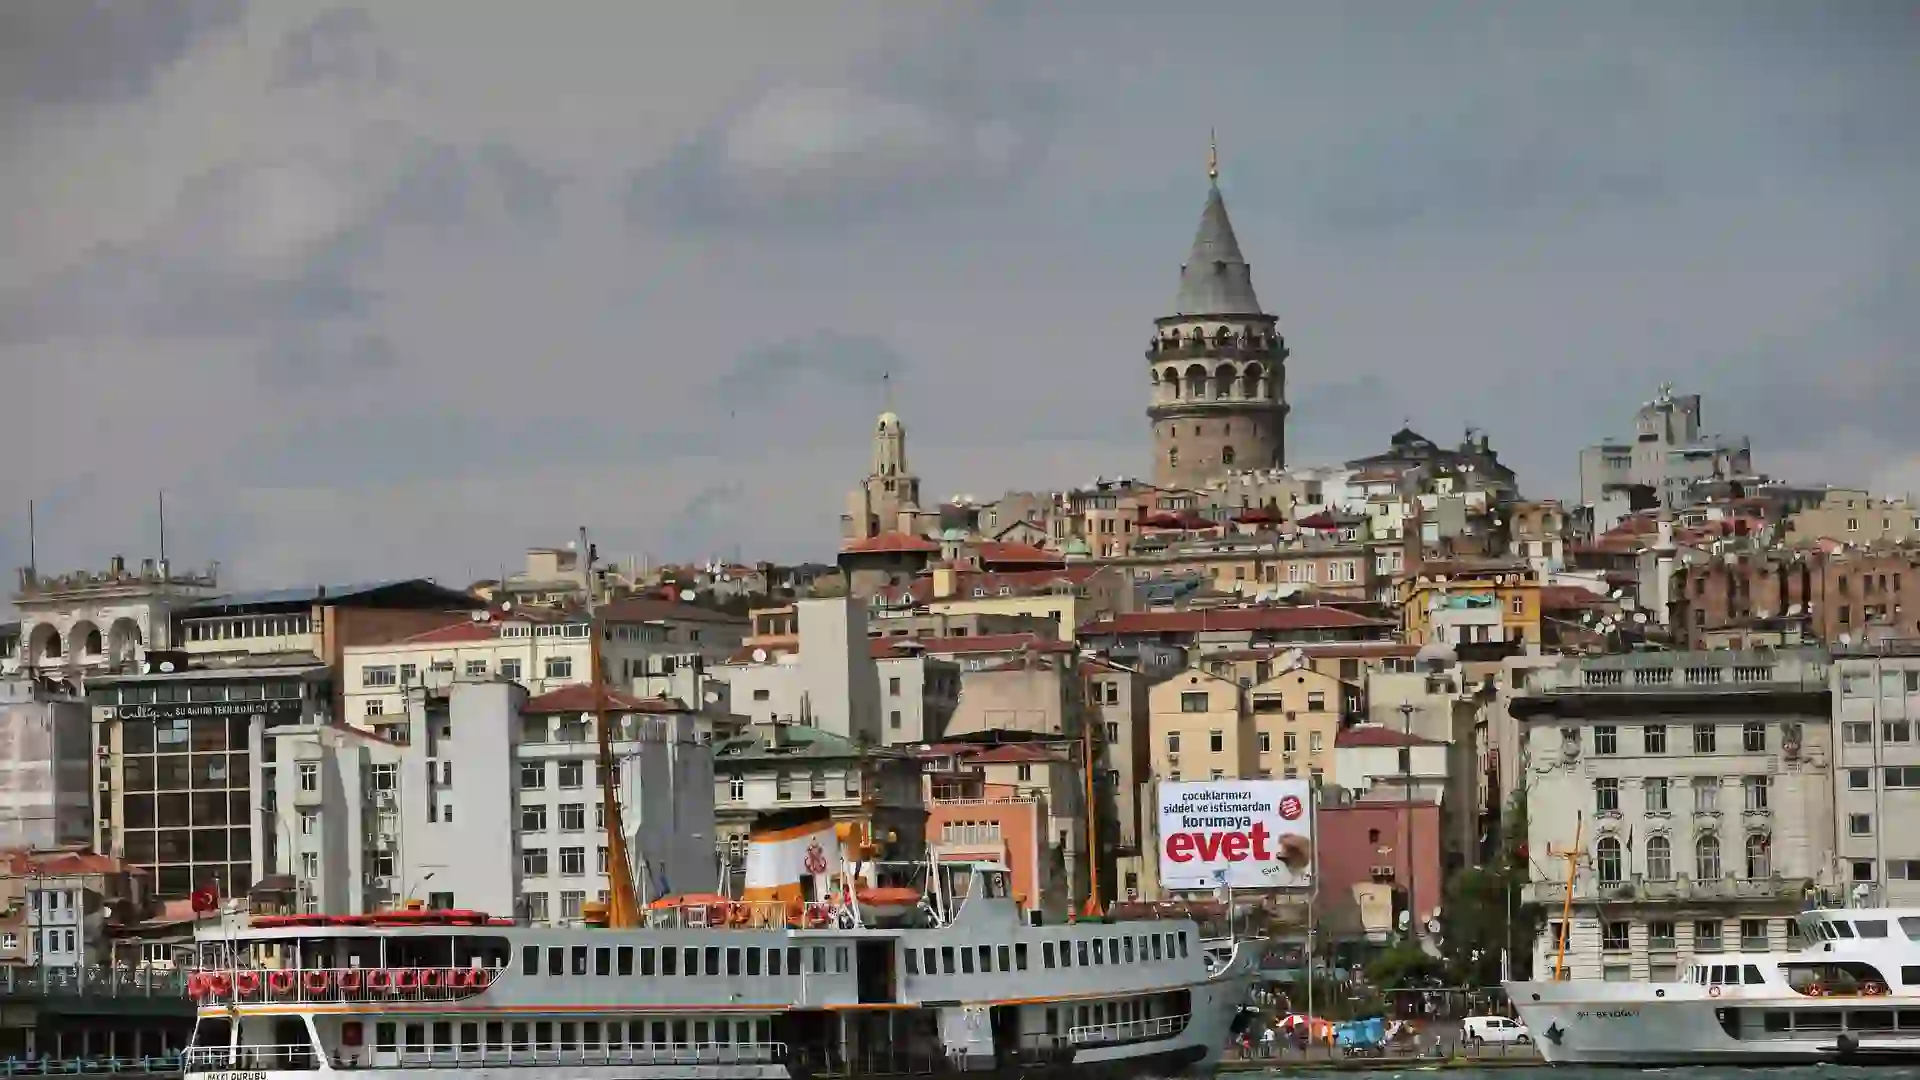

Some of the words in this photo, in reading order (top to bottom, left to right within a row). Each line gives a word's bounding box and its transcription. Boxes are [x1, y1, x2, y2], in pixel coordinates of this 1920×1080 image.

[1182, 790, 1252, 803] çocuklarımızı
[1197, 804, 1208, 813] ve
[1209, 801, 1271, 813] istismardan
[1182, 814, 1252, 830] korumaya
[1166, 820, 1271, 863] evet
